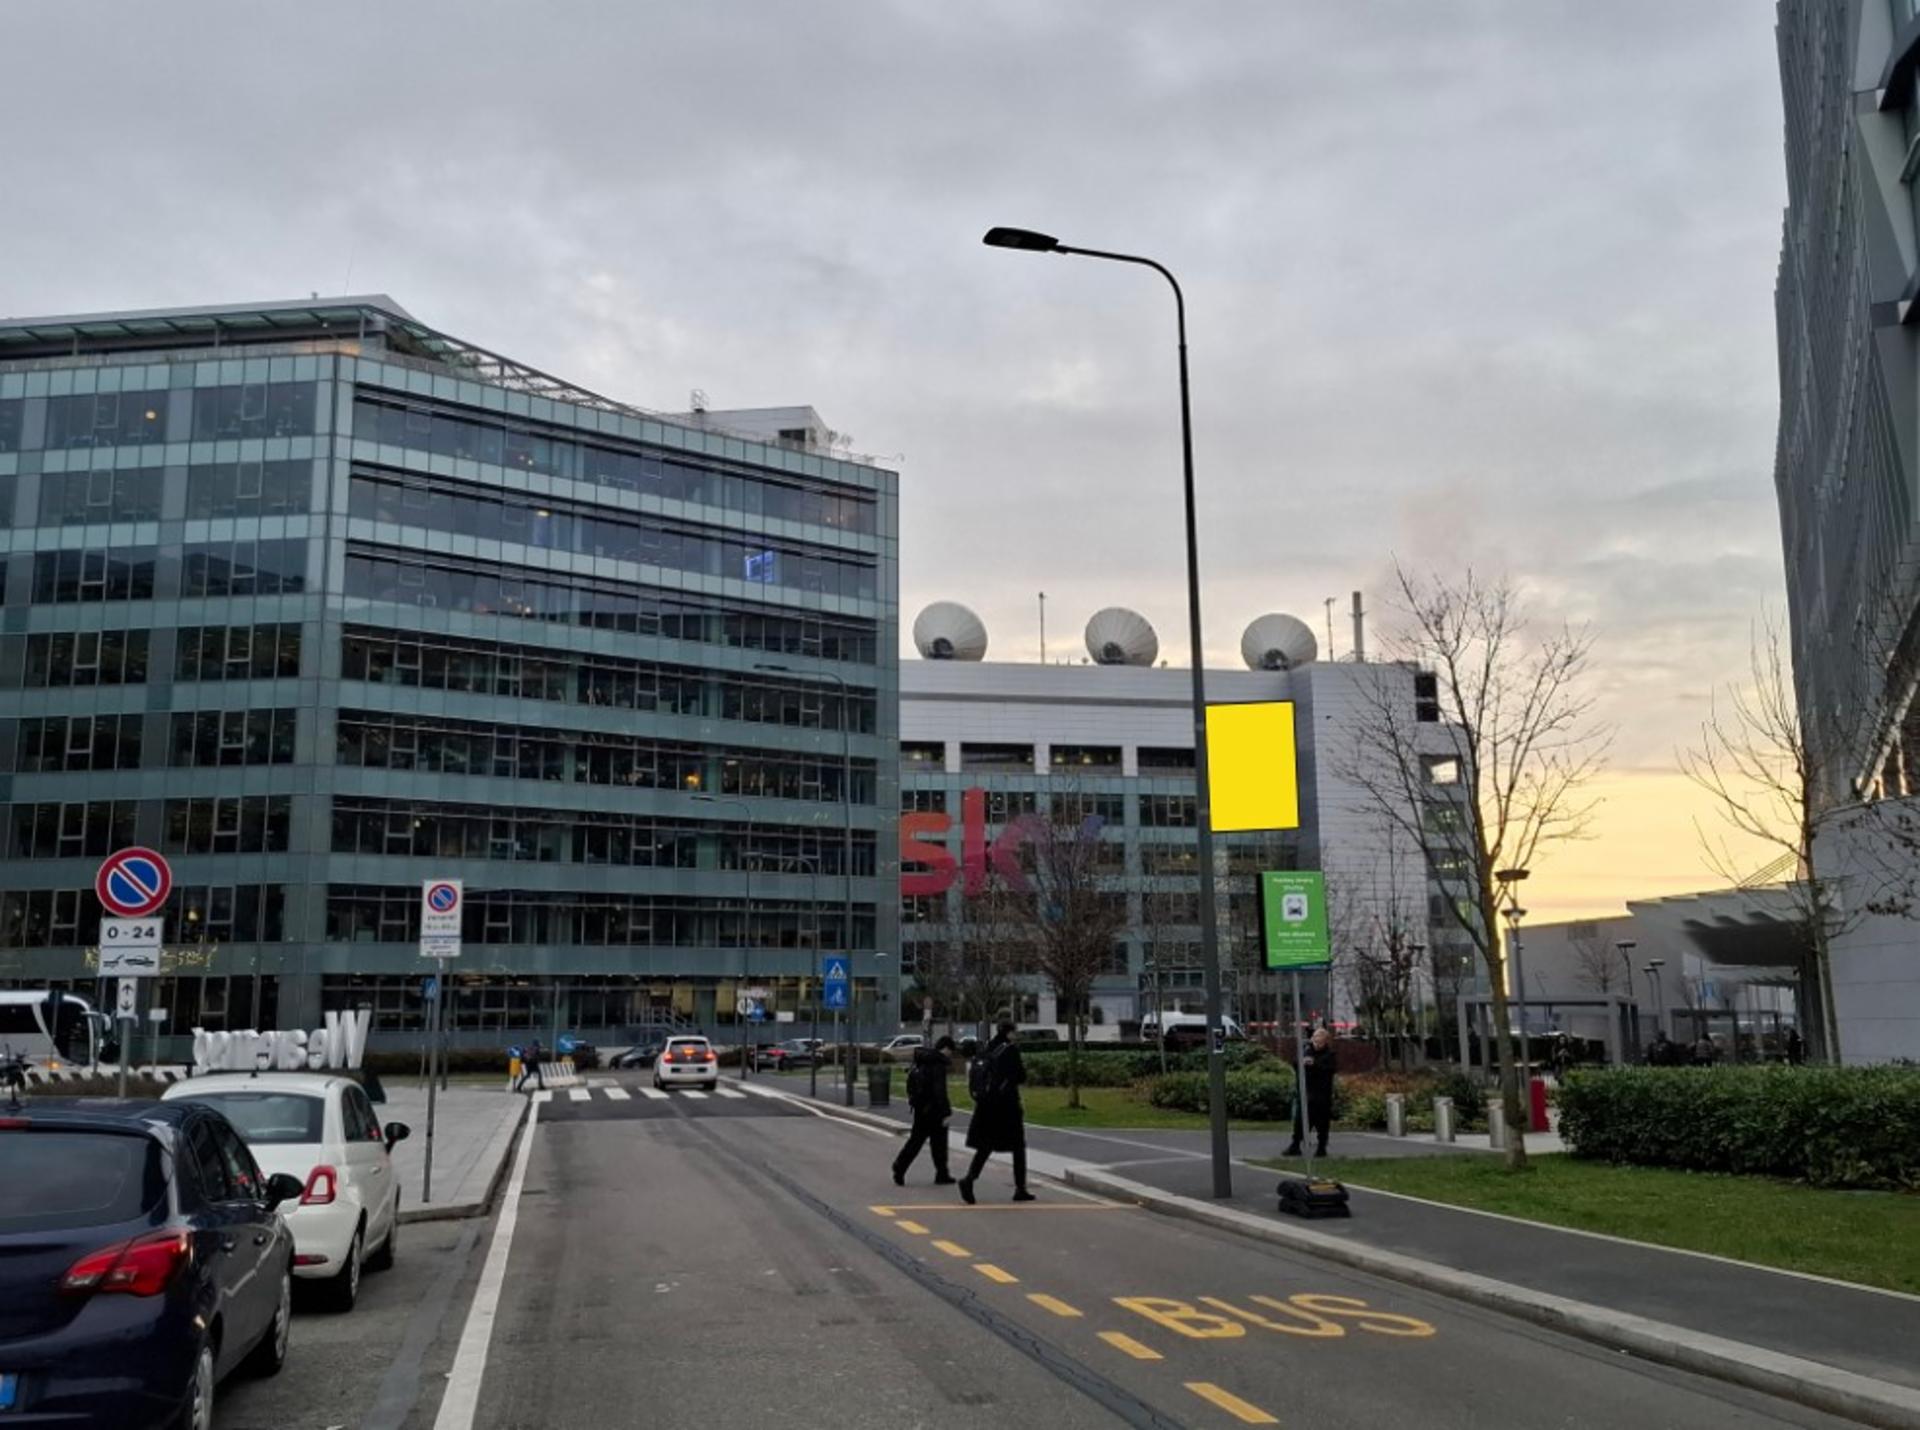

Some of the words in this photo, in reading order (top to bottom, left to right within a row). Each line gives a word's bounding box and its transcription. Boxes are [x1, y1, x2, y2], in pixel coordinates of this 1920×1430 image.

[107, 926, 118, 939] 0
[132, 926, 155, 938] 24
[1112, 1294, 1437, 1338] BUS
